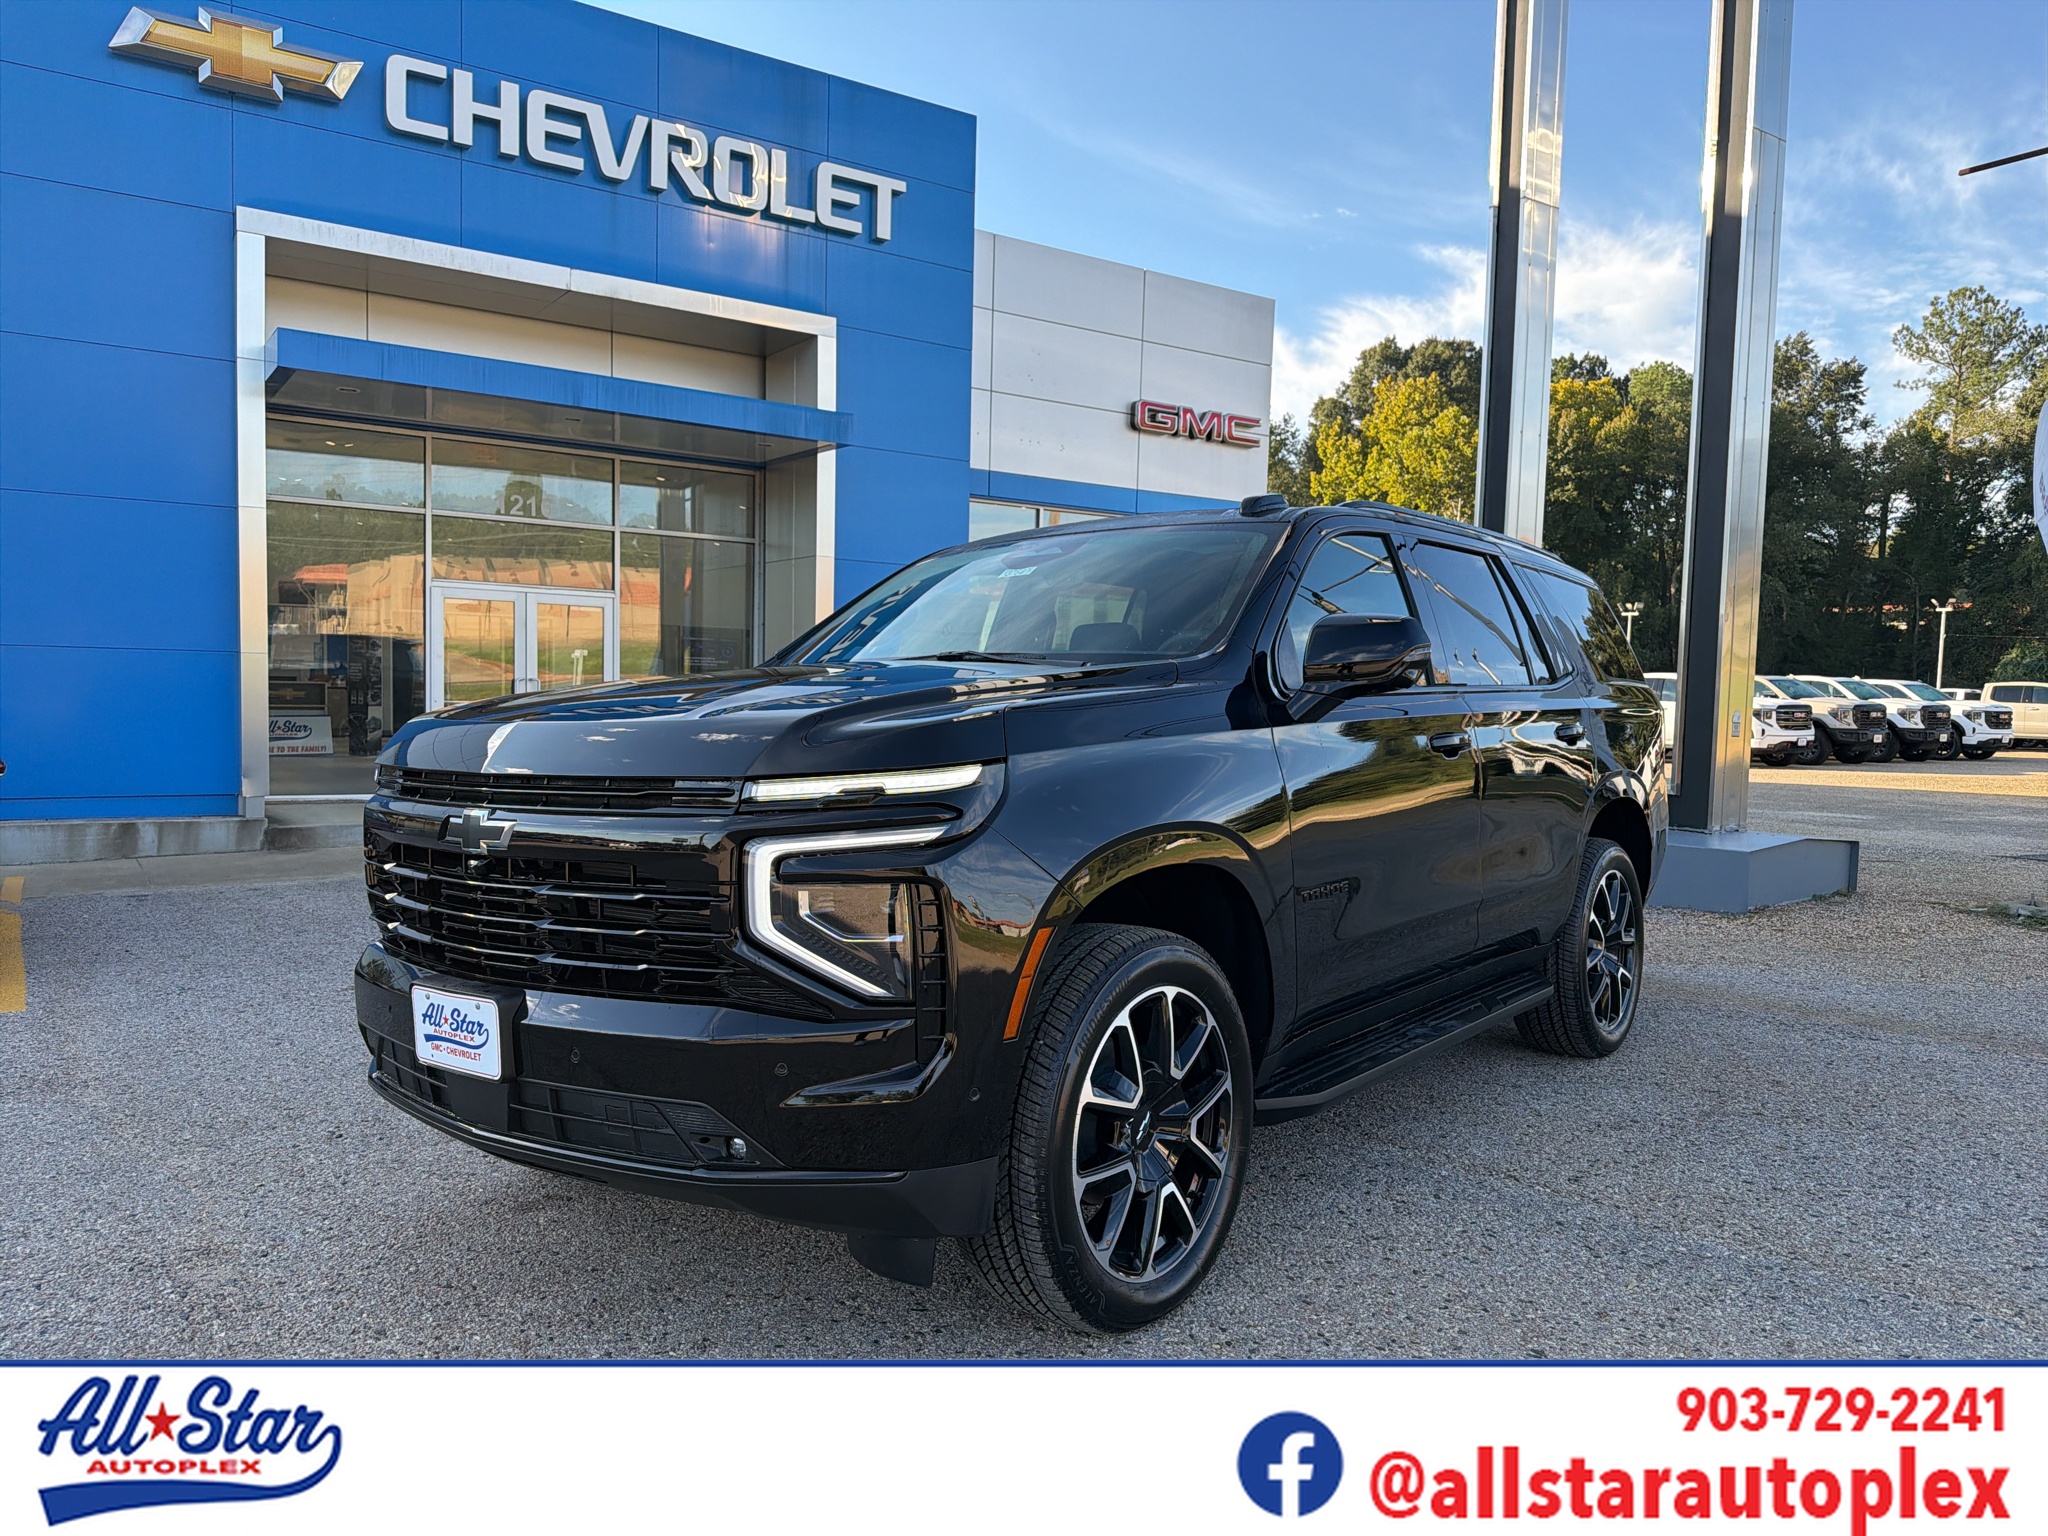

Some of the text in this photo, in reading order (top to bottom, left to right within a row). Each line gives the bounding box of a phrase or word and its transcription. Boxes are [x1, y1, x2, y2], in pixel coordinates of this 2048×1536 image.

[385, 54, 906, 241] CHEVROLET
[1132, 399, 1262, 448] GMC
[282, 720, 312, 734] Star
[421, 1002, 489, 1037] All Star
[433, 1028, 475, 1043] AUTOPLEX
[430, 1042, 481, 1061] GMC CHEVROLET
